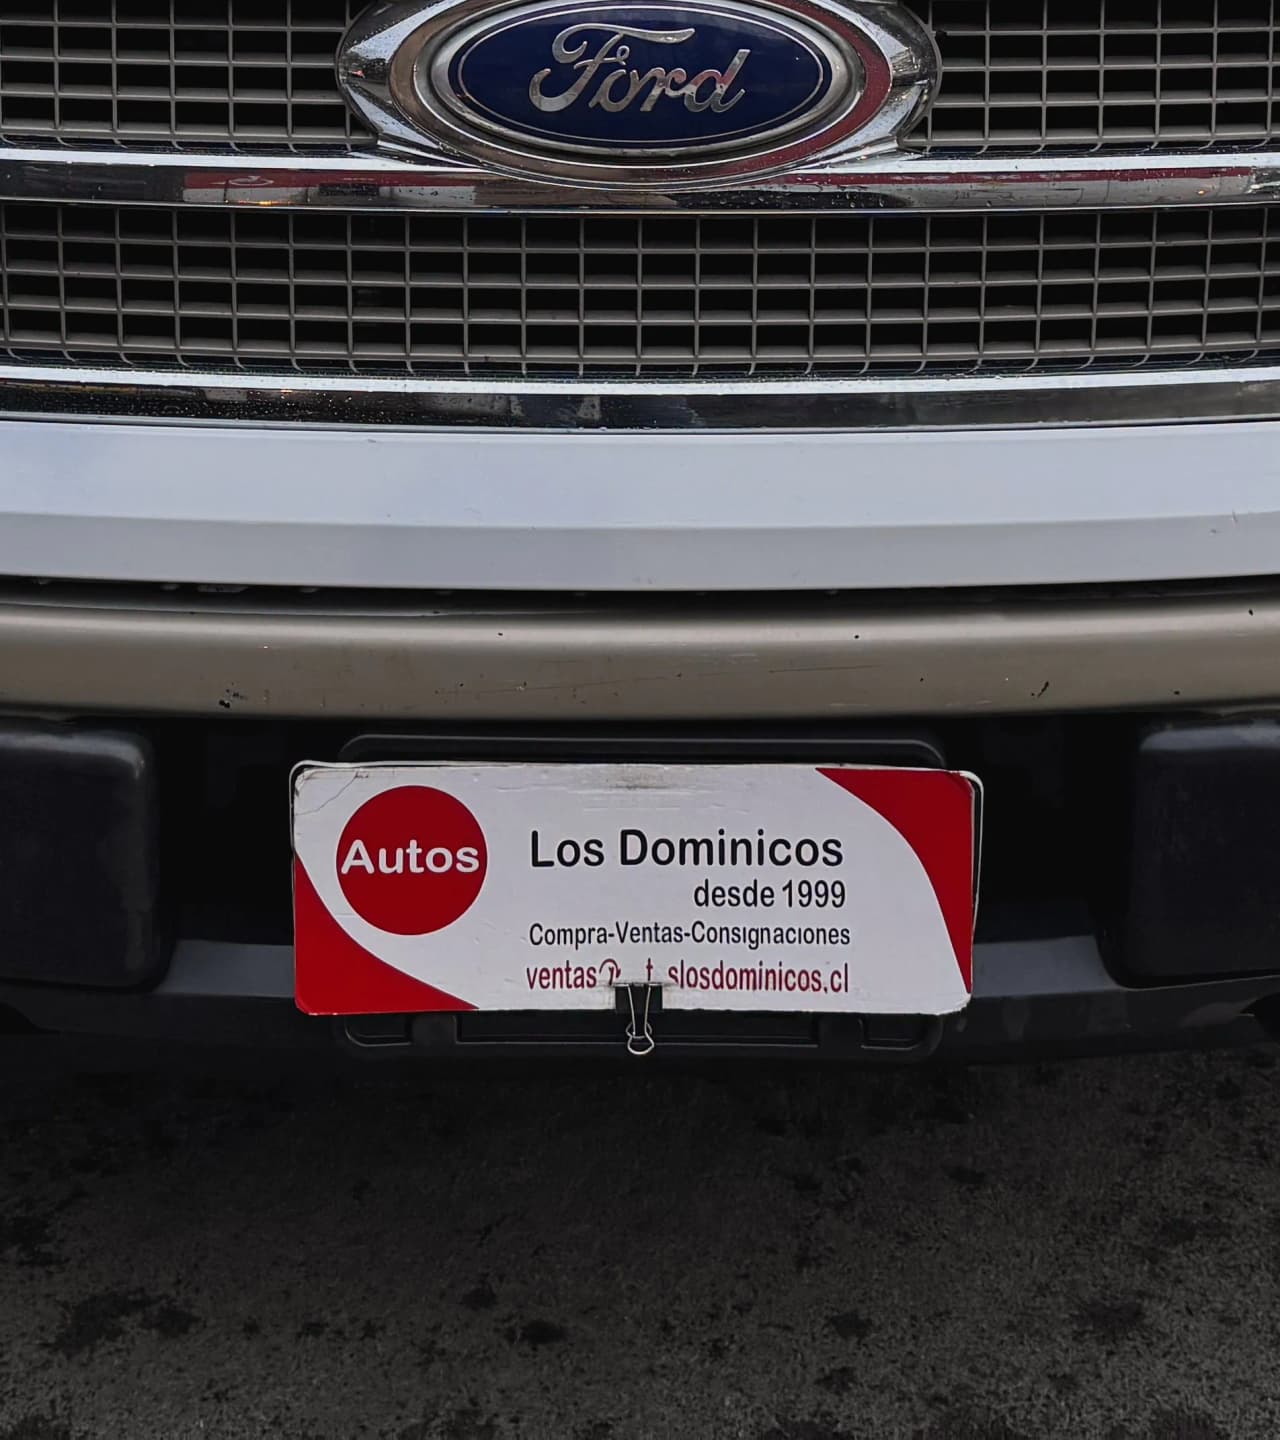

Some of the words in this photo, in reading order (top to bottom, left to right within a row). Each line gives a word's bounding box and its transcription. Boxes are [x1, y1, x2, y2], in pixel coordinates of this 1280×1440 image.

[528, 21, 751, 113] Ford
[340, 838, 480, 874] Autos
[530, 829, 605, 868] Los
[619, 828, 844, 867] Dominicos
[693, 878, 775, 908] desde
[781, 879, 847, 909] 1999
[528, 920, 851, 950] Compra-Ventas-Consignaciones
